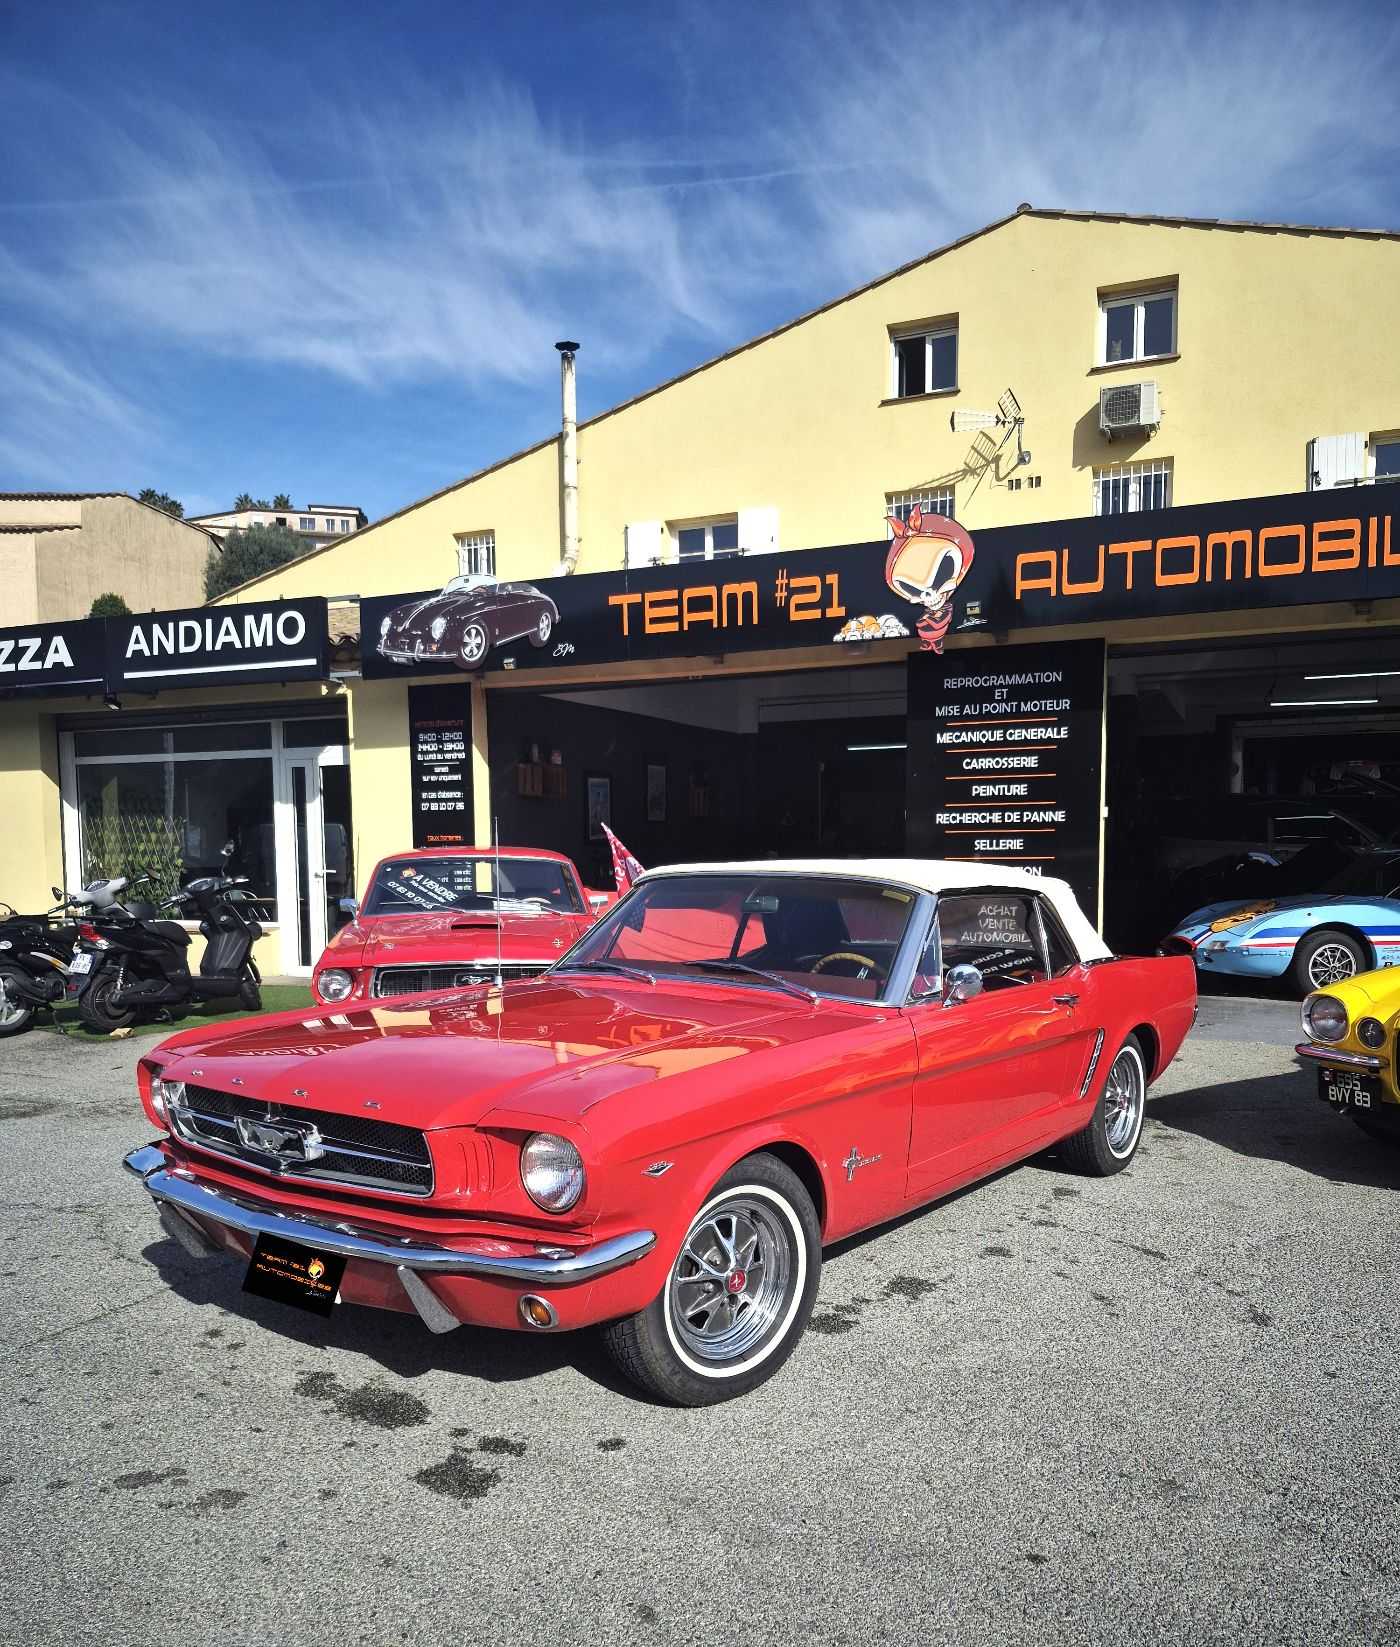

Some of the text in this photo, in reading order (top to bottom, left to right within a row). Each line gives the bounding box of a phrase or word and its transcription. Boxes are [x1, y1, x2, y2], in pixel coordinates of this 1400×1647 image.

[1015, 516, 1400, 600] AUTOMOBIL
[608, 568, 847, 636] TEAM #21
[125, 610, 306, 659] ANDIAMO
[944, 672, 1063, 689] REPROGRAMMATION
[995, 688, 1008, 700] ET
[935, 699, 1071, 717] MISE AU POINT MOTEUR
[936, 727, 1069, 744] MECANIQUE GENERALE
[962, 756, 1039, 770] CARROSSERIE
[971, 784, 1028, 797] PEINTURE
[935, 810, 1066, 824] RECHERCHE DE PANNE
[974, 839, 1024, 851] SELLERIE
[977, 905, 1018, 917] ACHAT
[978, 919, 1017, 930] VENTE
[1328, 1085, 1371, 1108] BVY 83
